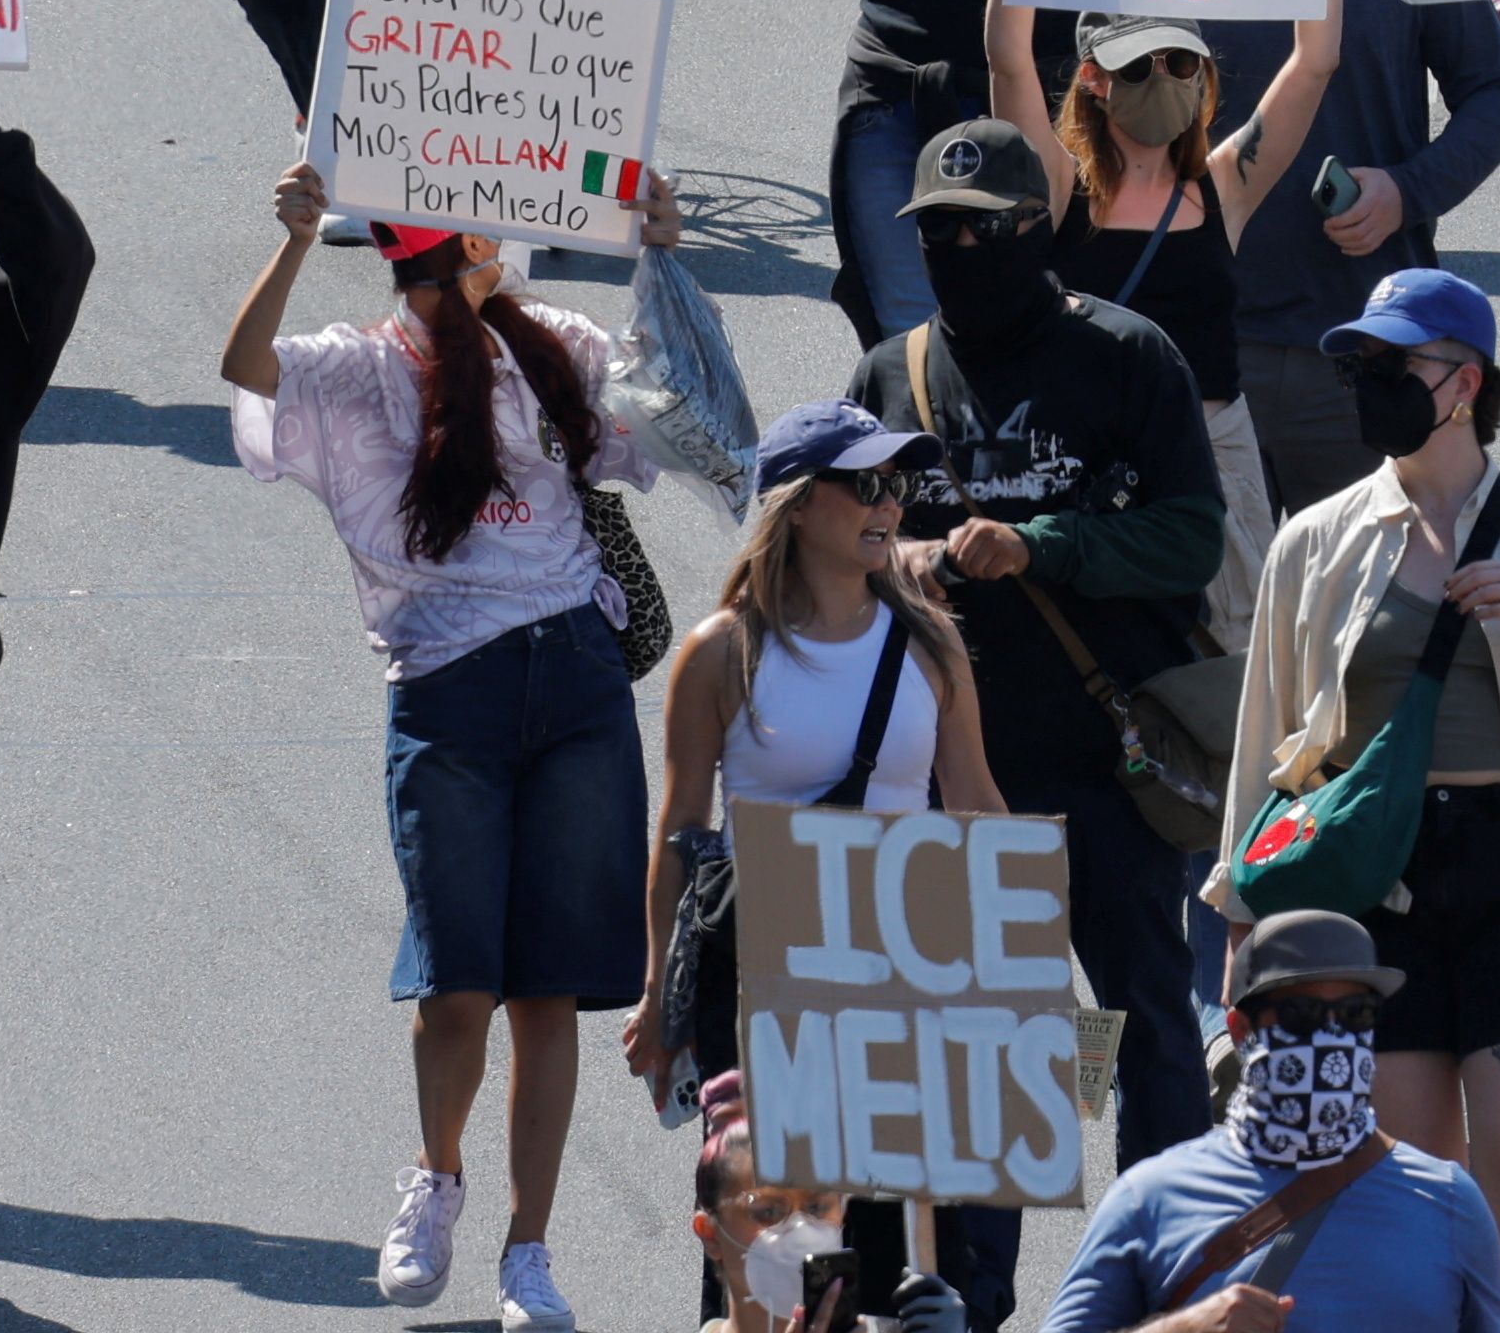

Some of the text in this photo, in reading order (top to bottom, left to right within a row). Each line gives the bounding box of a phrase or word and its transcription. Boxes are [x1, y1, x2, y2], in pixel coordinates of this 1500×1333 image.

[344, 9, 511, 75] GRITAR
[575, 51, 635, 106] que
[348, 63, 410, 113] Tus
[418, 61, 530, 120] Padres
[537, 93, 563, 150] y
[420, 126, 567, 175] CALLAN
[403, 163, 589, 232] Por Miedo
[786, 812, 1072, 995] ICE
[748, 1003, 1082, 1203] MELTS
